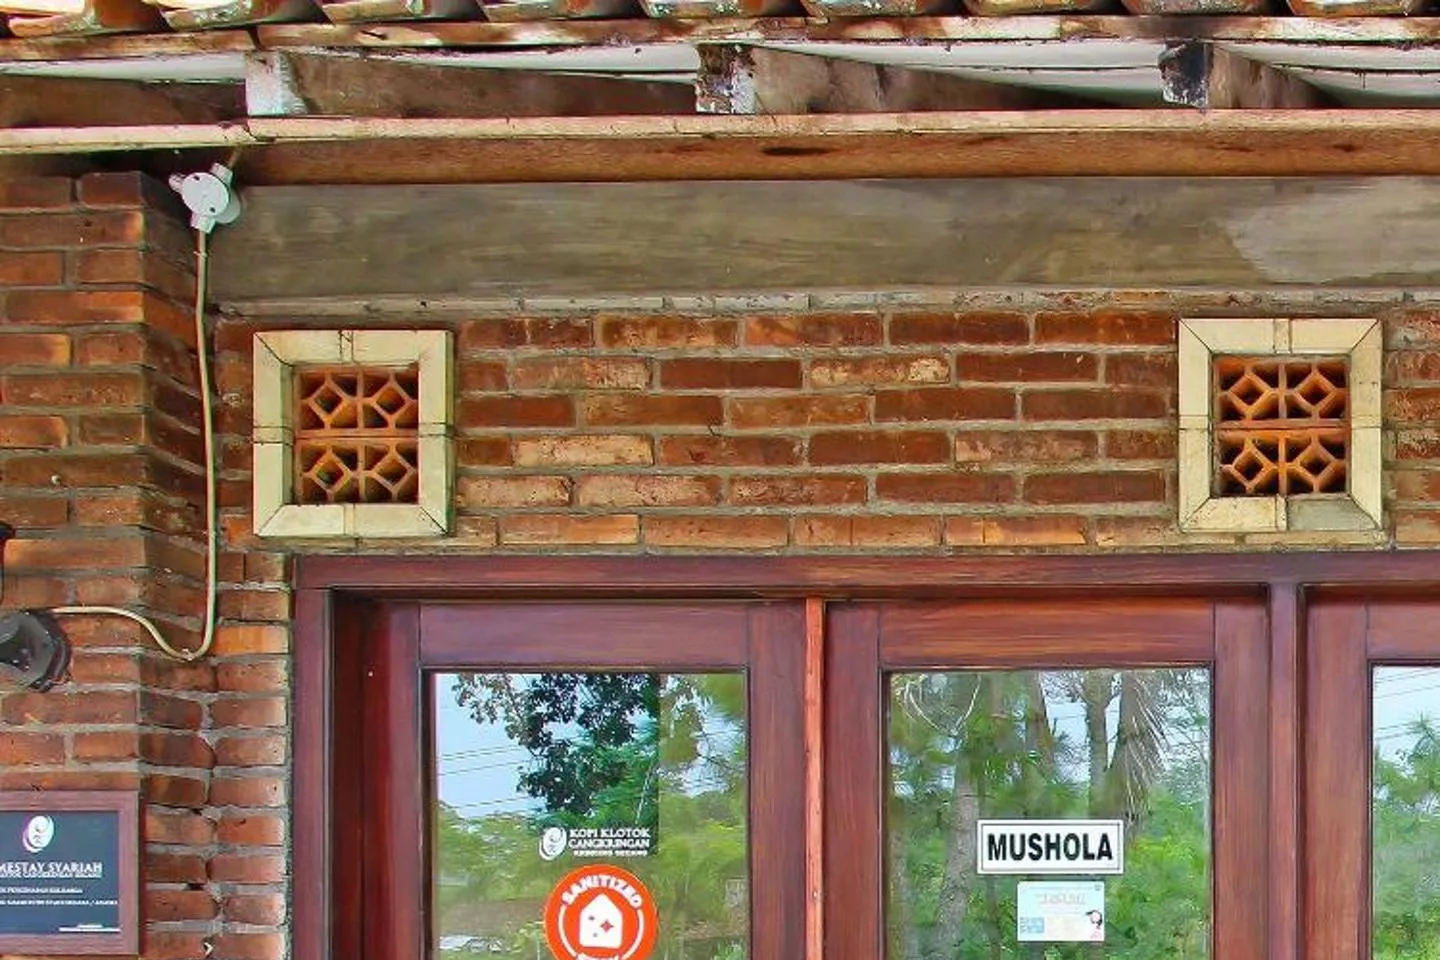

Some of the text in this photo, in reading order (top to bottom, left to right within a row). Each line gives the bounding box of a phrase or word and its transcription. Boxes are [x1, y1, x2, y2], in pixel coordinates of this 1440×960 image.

[569, 828, 652, 838] KOPI KLOTOK
[987, 832, 1113, 861] MUSHOLA
[49, 861, 103, 873] SYARIAH
[561, 874, 643, 909] SANITIZED
